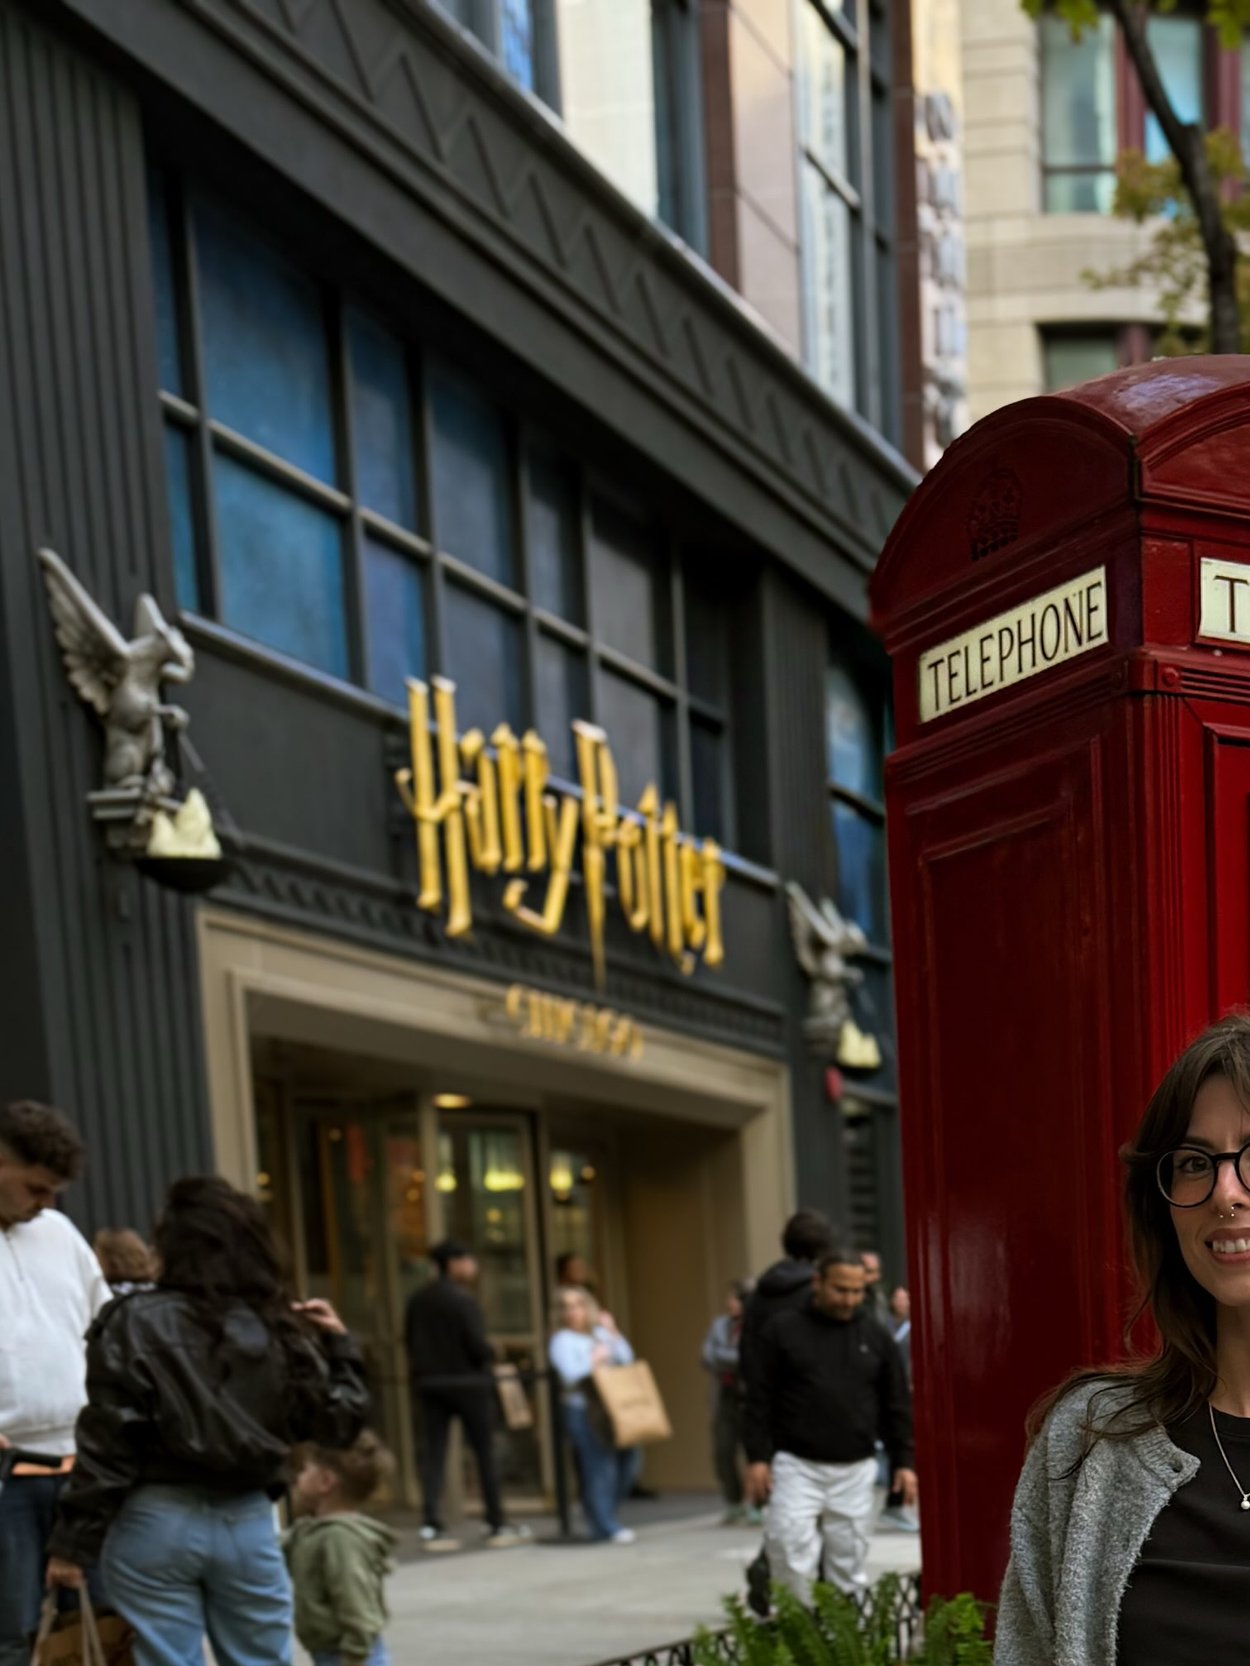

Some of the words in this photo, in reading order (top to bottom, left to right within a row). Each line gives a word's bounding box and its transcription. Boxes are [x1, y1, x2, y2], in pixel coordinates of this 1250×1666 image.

[927, 580, 1103, 712] TELEPHONE
[395, 674, 579, 938] Harry
[572, 718, 726, 998] Potter
